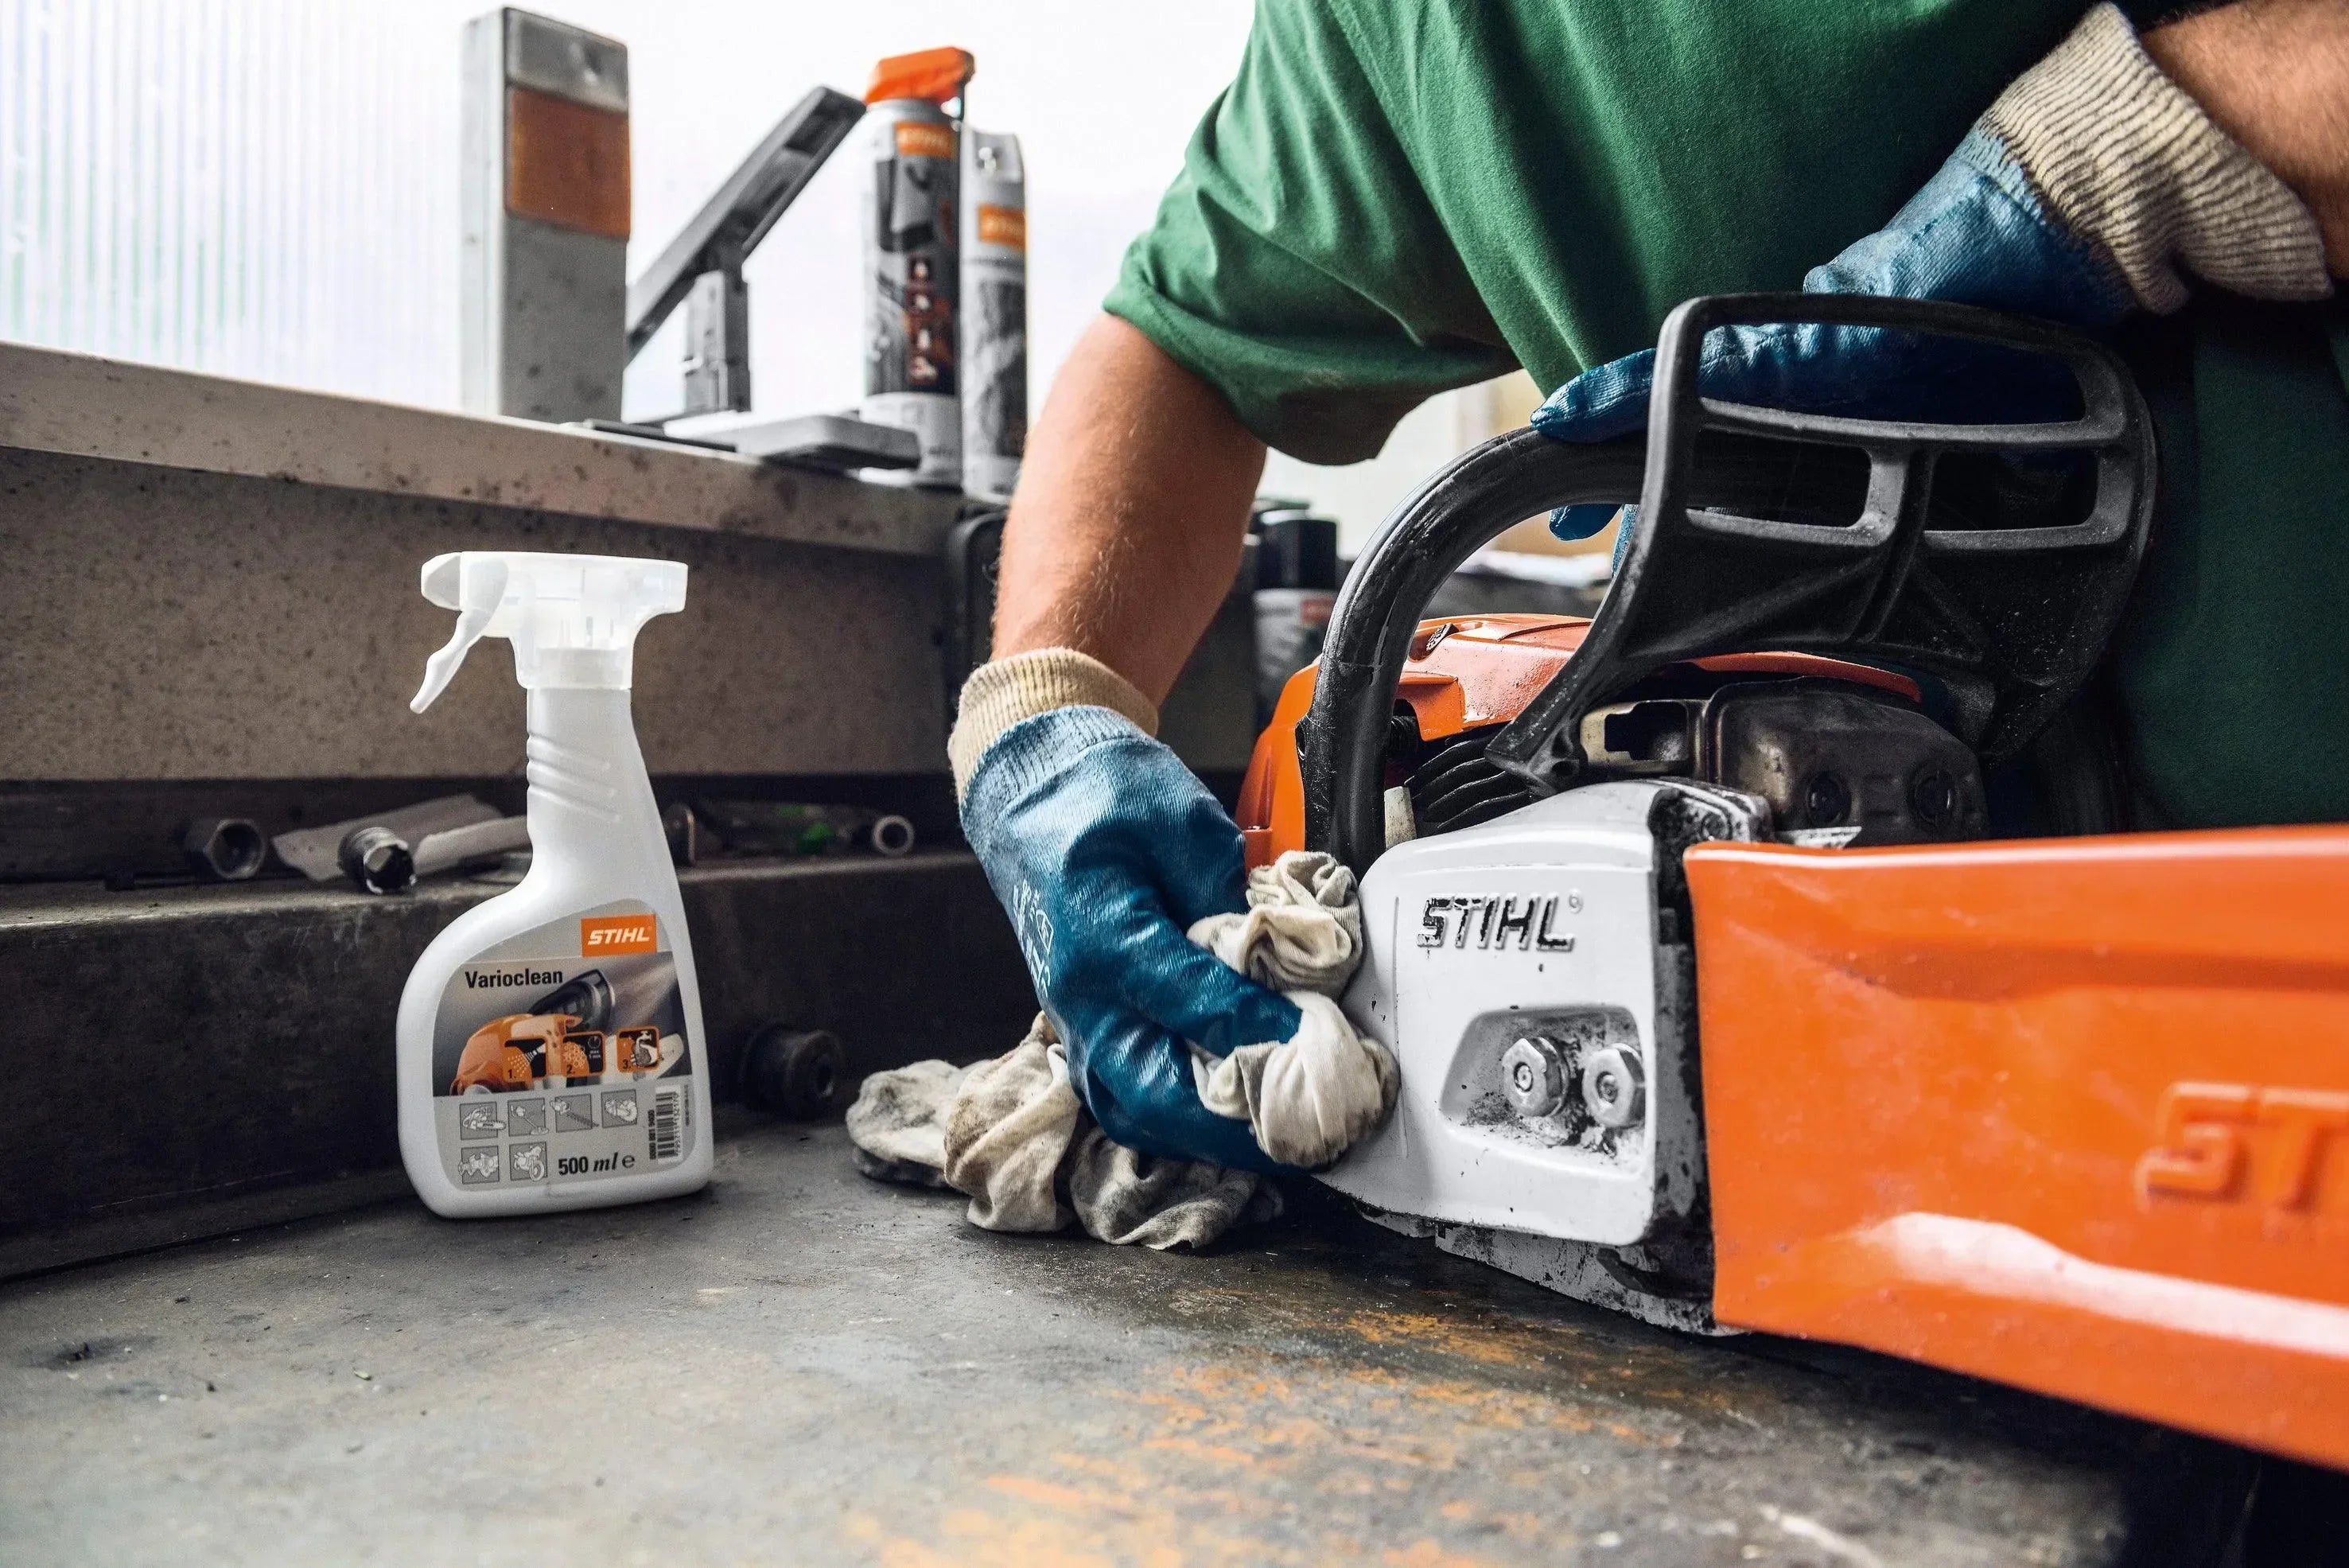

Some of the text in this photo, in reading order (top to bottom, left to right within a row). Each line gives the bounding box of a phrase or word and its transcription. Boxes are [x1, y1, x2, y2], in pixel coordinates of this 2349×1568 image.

[1417, 895, 1576, 951] STIHL
[588, 927, 650, 945] STIHL
[465, 968, 563, 989] Varioclean
[558, 1156, 589, 1176] 500
[593, 1152, 618, 1172] ml
